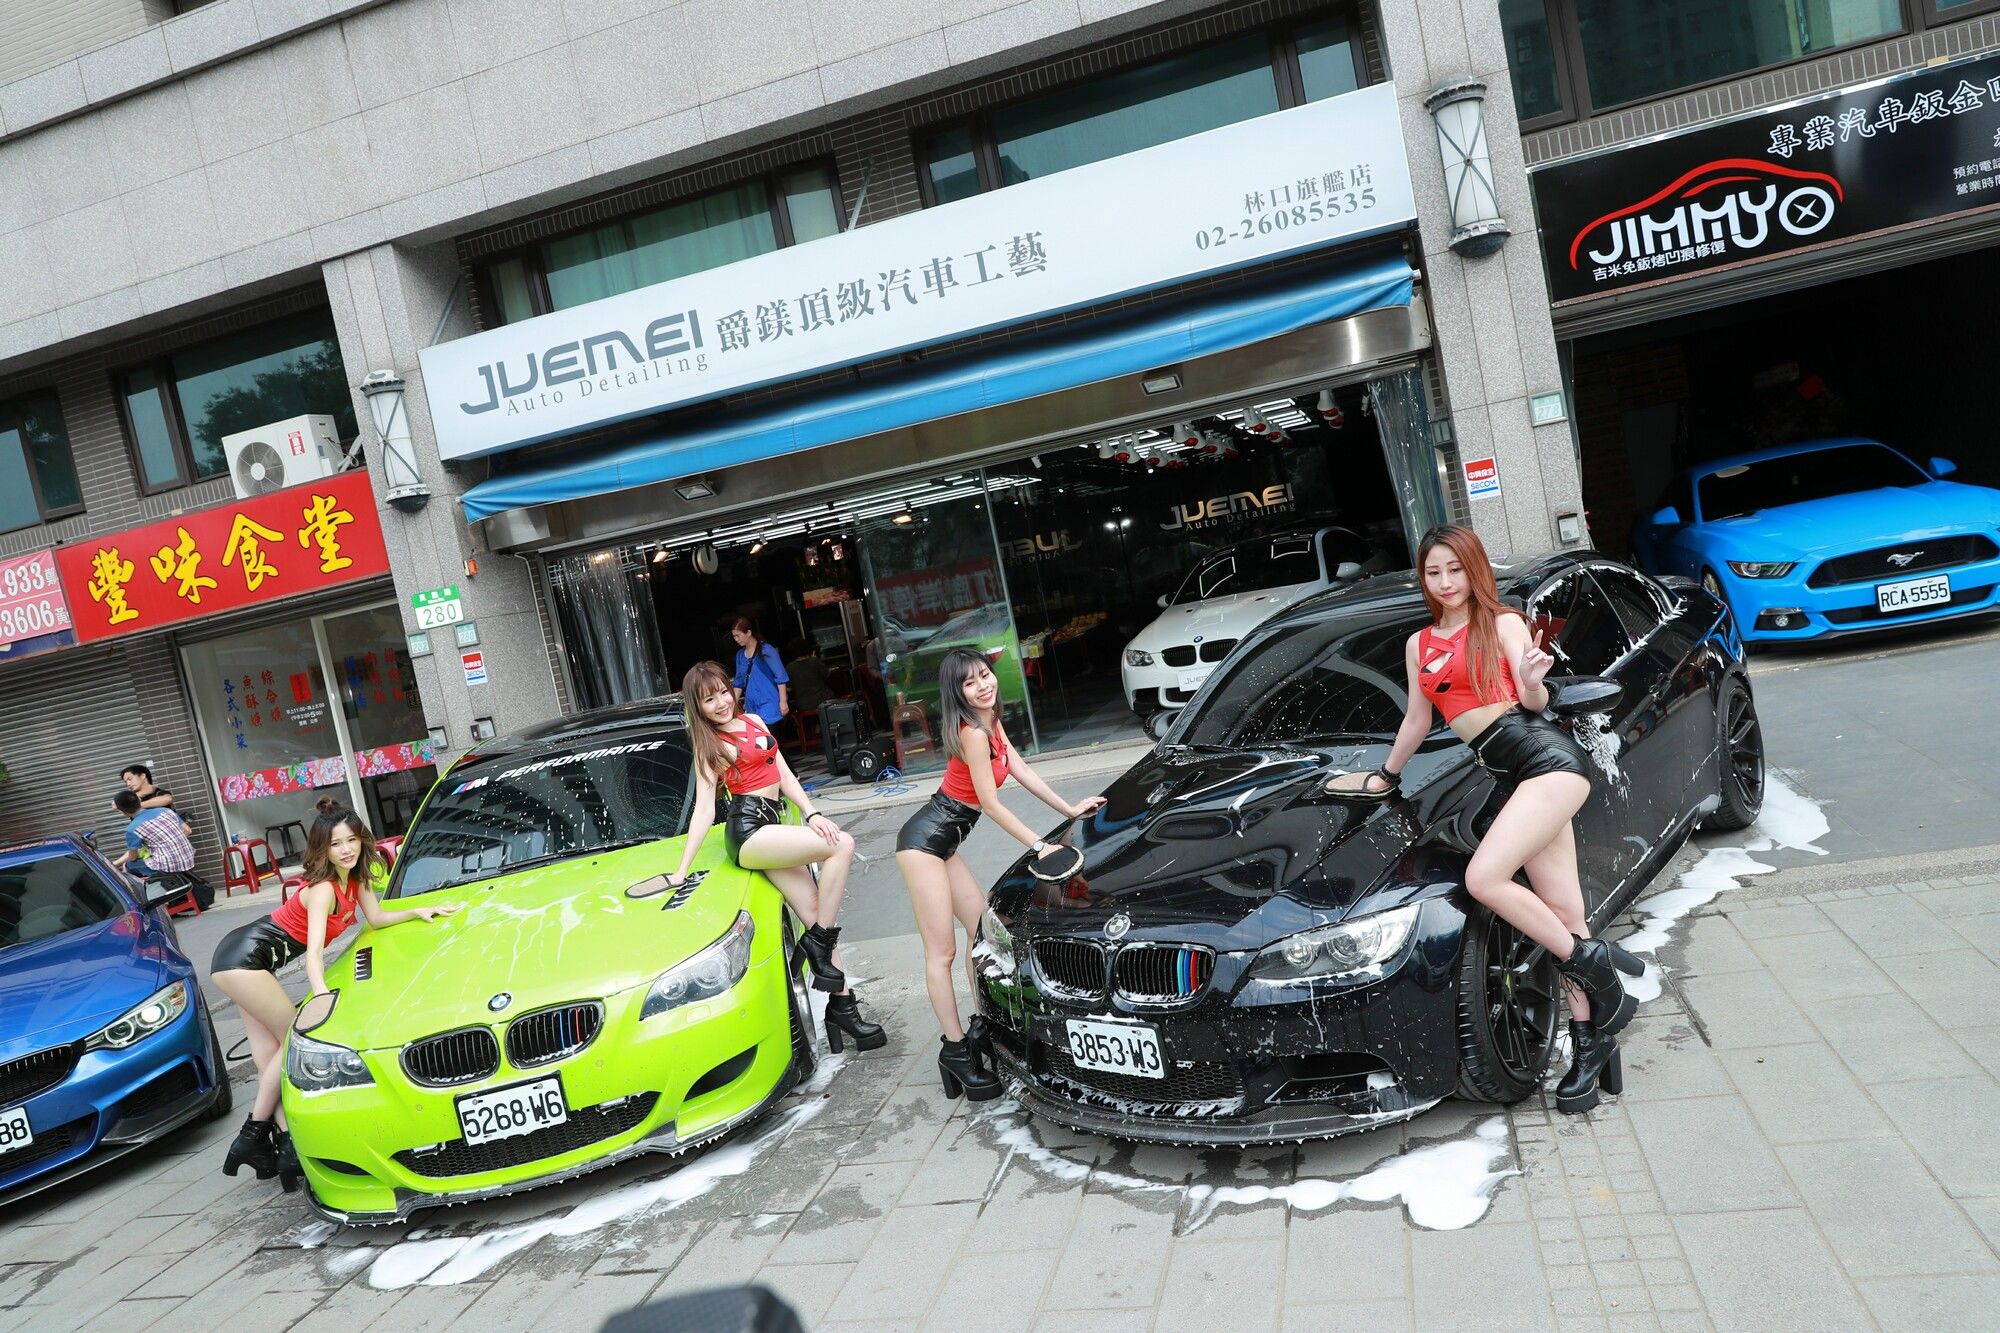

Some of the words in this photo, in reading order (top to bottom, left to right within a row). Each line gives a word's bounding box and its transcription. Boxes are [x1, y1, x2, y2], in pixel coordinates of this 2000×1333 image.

[1244, 164, 1371, 215] 林口旗艦店
[1195, 188, 1377, 250] 02-26085535
[1593, 240, 1727, 282] 吉米免鈑烤凹痕修復
[715, 231, 1048, 353] 爵鎂頂級汽車工藝
[460, 309, 704, 415] JUEMEI
[507, 390, 564, 416] Auto
[578, 353, 708, 398] Detailing
[1160, 482, 1294, 530] JUEMEI
[1470, 479, 1497, 491] SECOM
[1186, 518, 1218, 531] Auto
[1226, 502, 1296, 523] Detailing
[87, 494, 355, 625] 豐味食堂
[0, 600, 55, 637] 3606
[423, 603, 457, 626] 280
[223, 679, 248, 750] 各式小菜
[495, 740, 666, 781] PERFORMANCE
